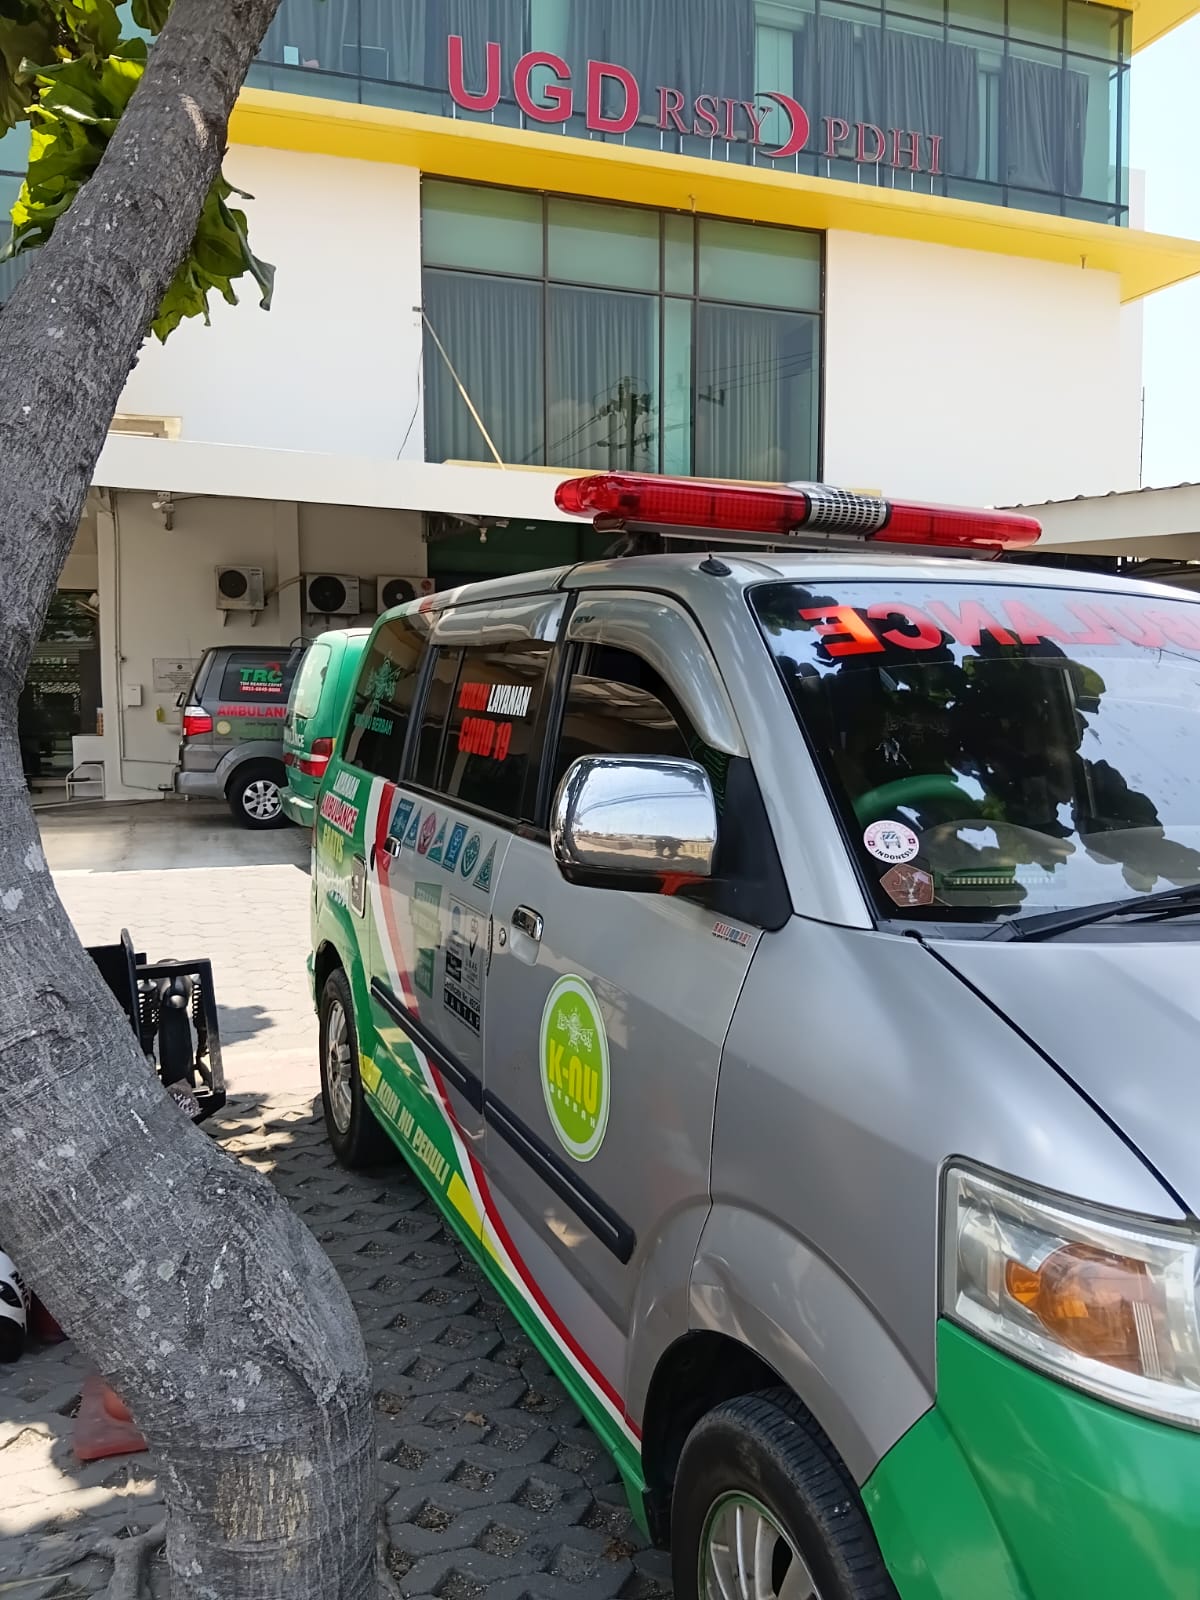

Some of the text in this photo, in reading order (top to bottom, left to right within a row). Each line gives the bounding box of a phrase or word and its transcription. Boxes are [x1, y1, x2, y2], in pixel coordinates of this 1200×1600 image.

[447, 34, 944, 174] UGD RSIY PDHI
[240, 668, 283, 682] TRC
[217, 706, 287, 717] AMBULAN
[487, 684, 532, 716] LAYANAN
[459, 717, 512, 761] COVID 19
[320, 792, 359, 837] AMBULANCE
[875, 847, 915, 860] INDONESIA
[397, 1106, 415, 1139] NU
[411, 1125, 450, 1187] PEDULI
